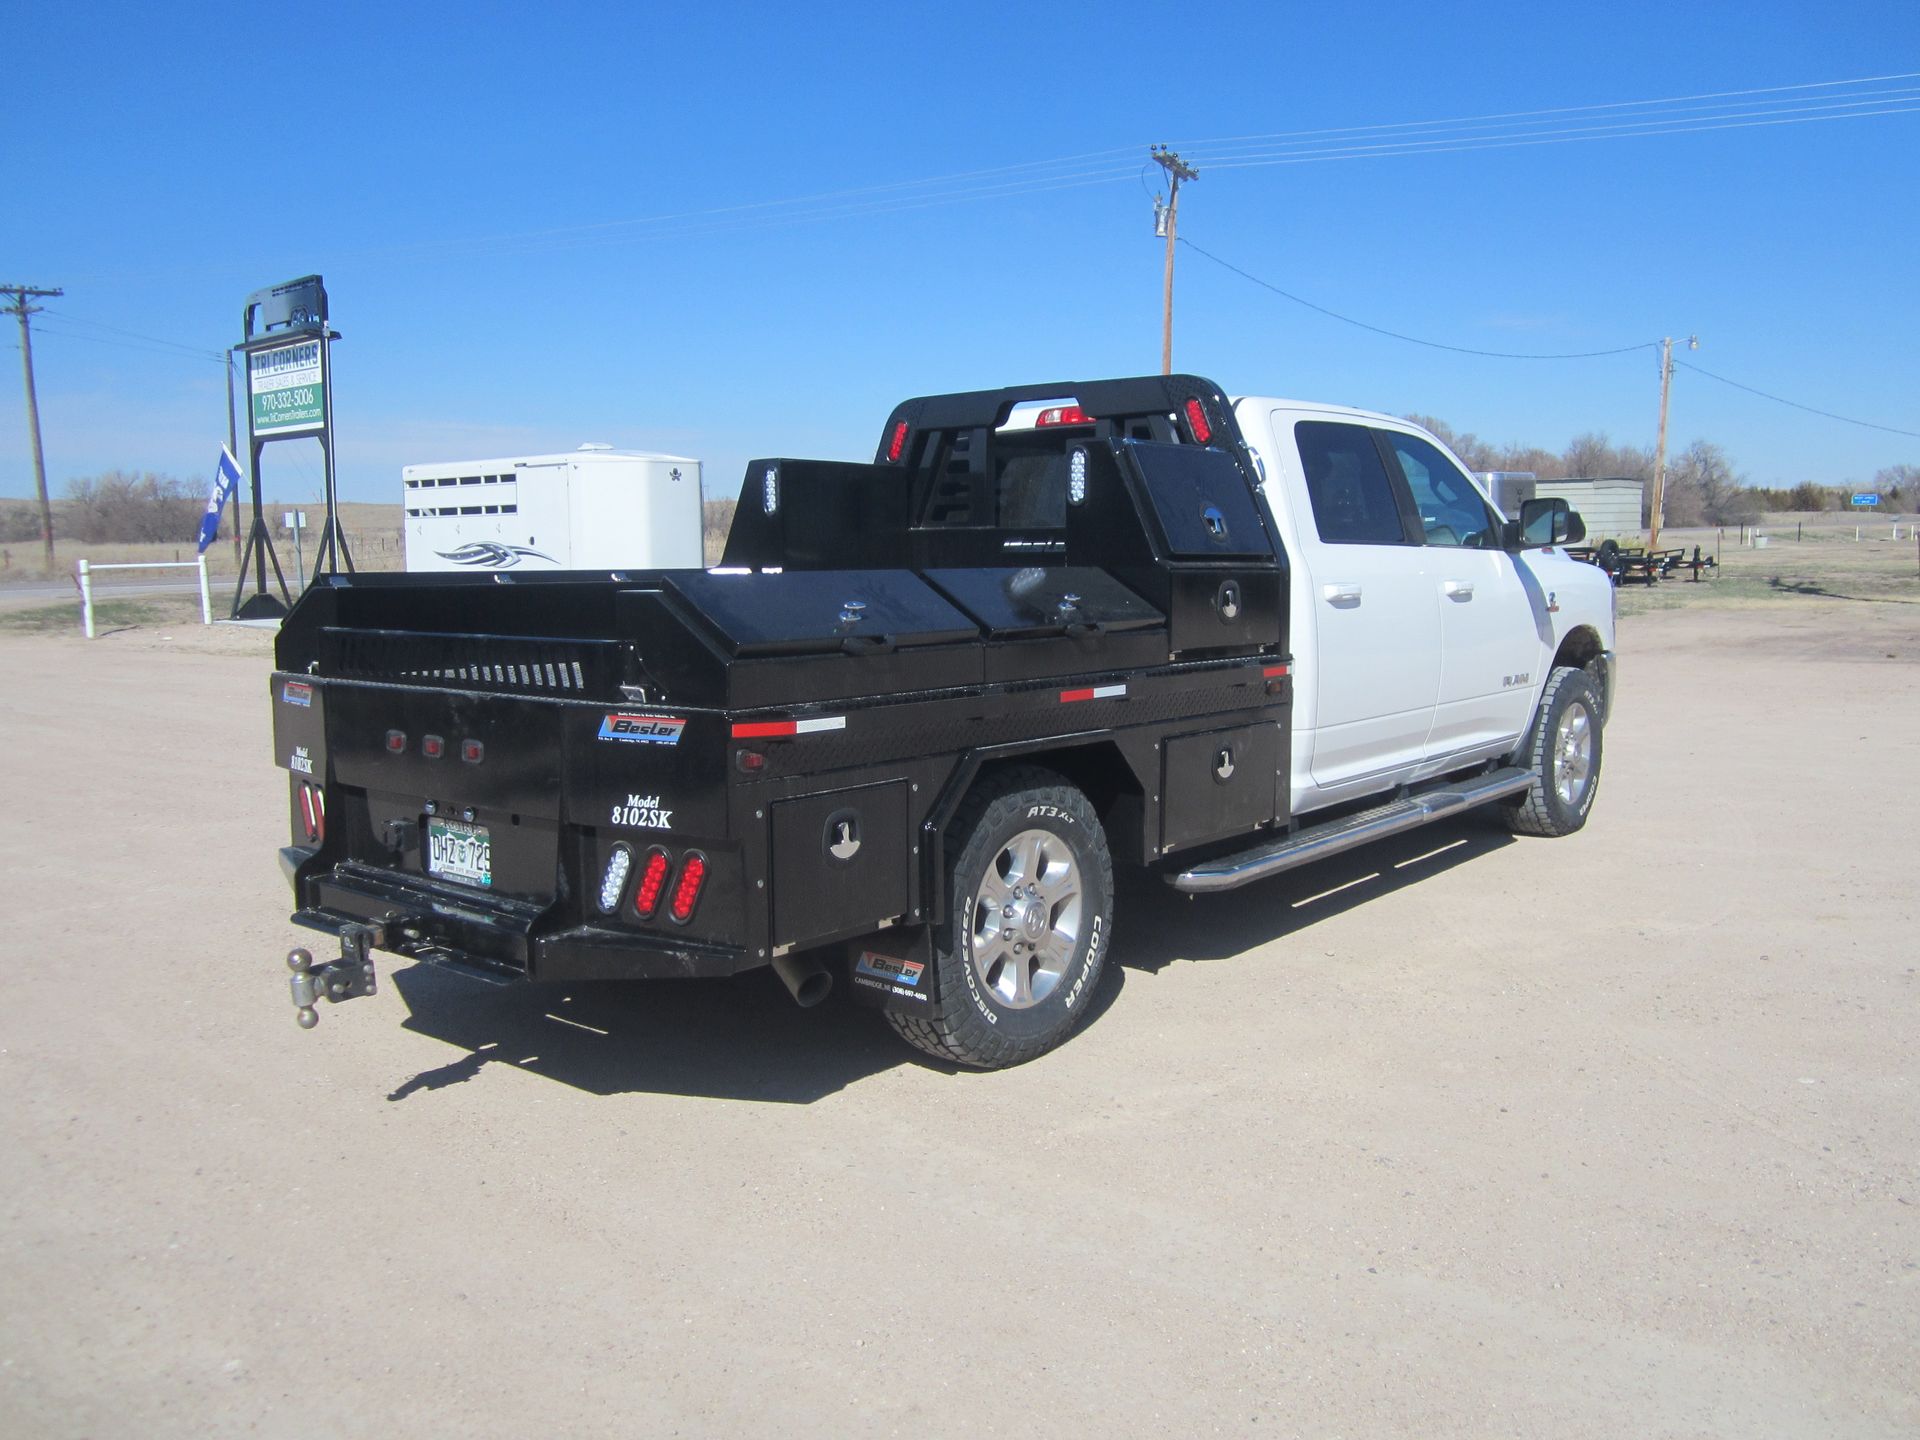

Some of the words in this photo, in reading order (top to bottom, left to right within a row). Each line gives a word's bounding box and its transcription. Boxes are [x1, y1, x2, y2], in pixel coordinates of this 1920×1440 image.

[254, 353, 271, 376] TRI
[273, 344, 319, 372] CORNERS
[296, 371, 318, 385] SERVICE
[262, 388, 314, 411] 970-332-5006
[1503, 673, 1529, 688] RAM
[611, 719, 676, 736] Besler
[627, 794, 660, 808] Model
[1579, 775, 1598, 816] COOPER
[611, 806, 673, 829] 8102SK
[1026, 805, 1059, 819] AT3
[1057, 810, 1075, 825] XLT
[872, 958, 918, 977] Besler
[961, 896, 998, 1025] DISCOVERER
[1064, 915, 1102, 1009] COOPER
